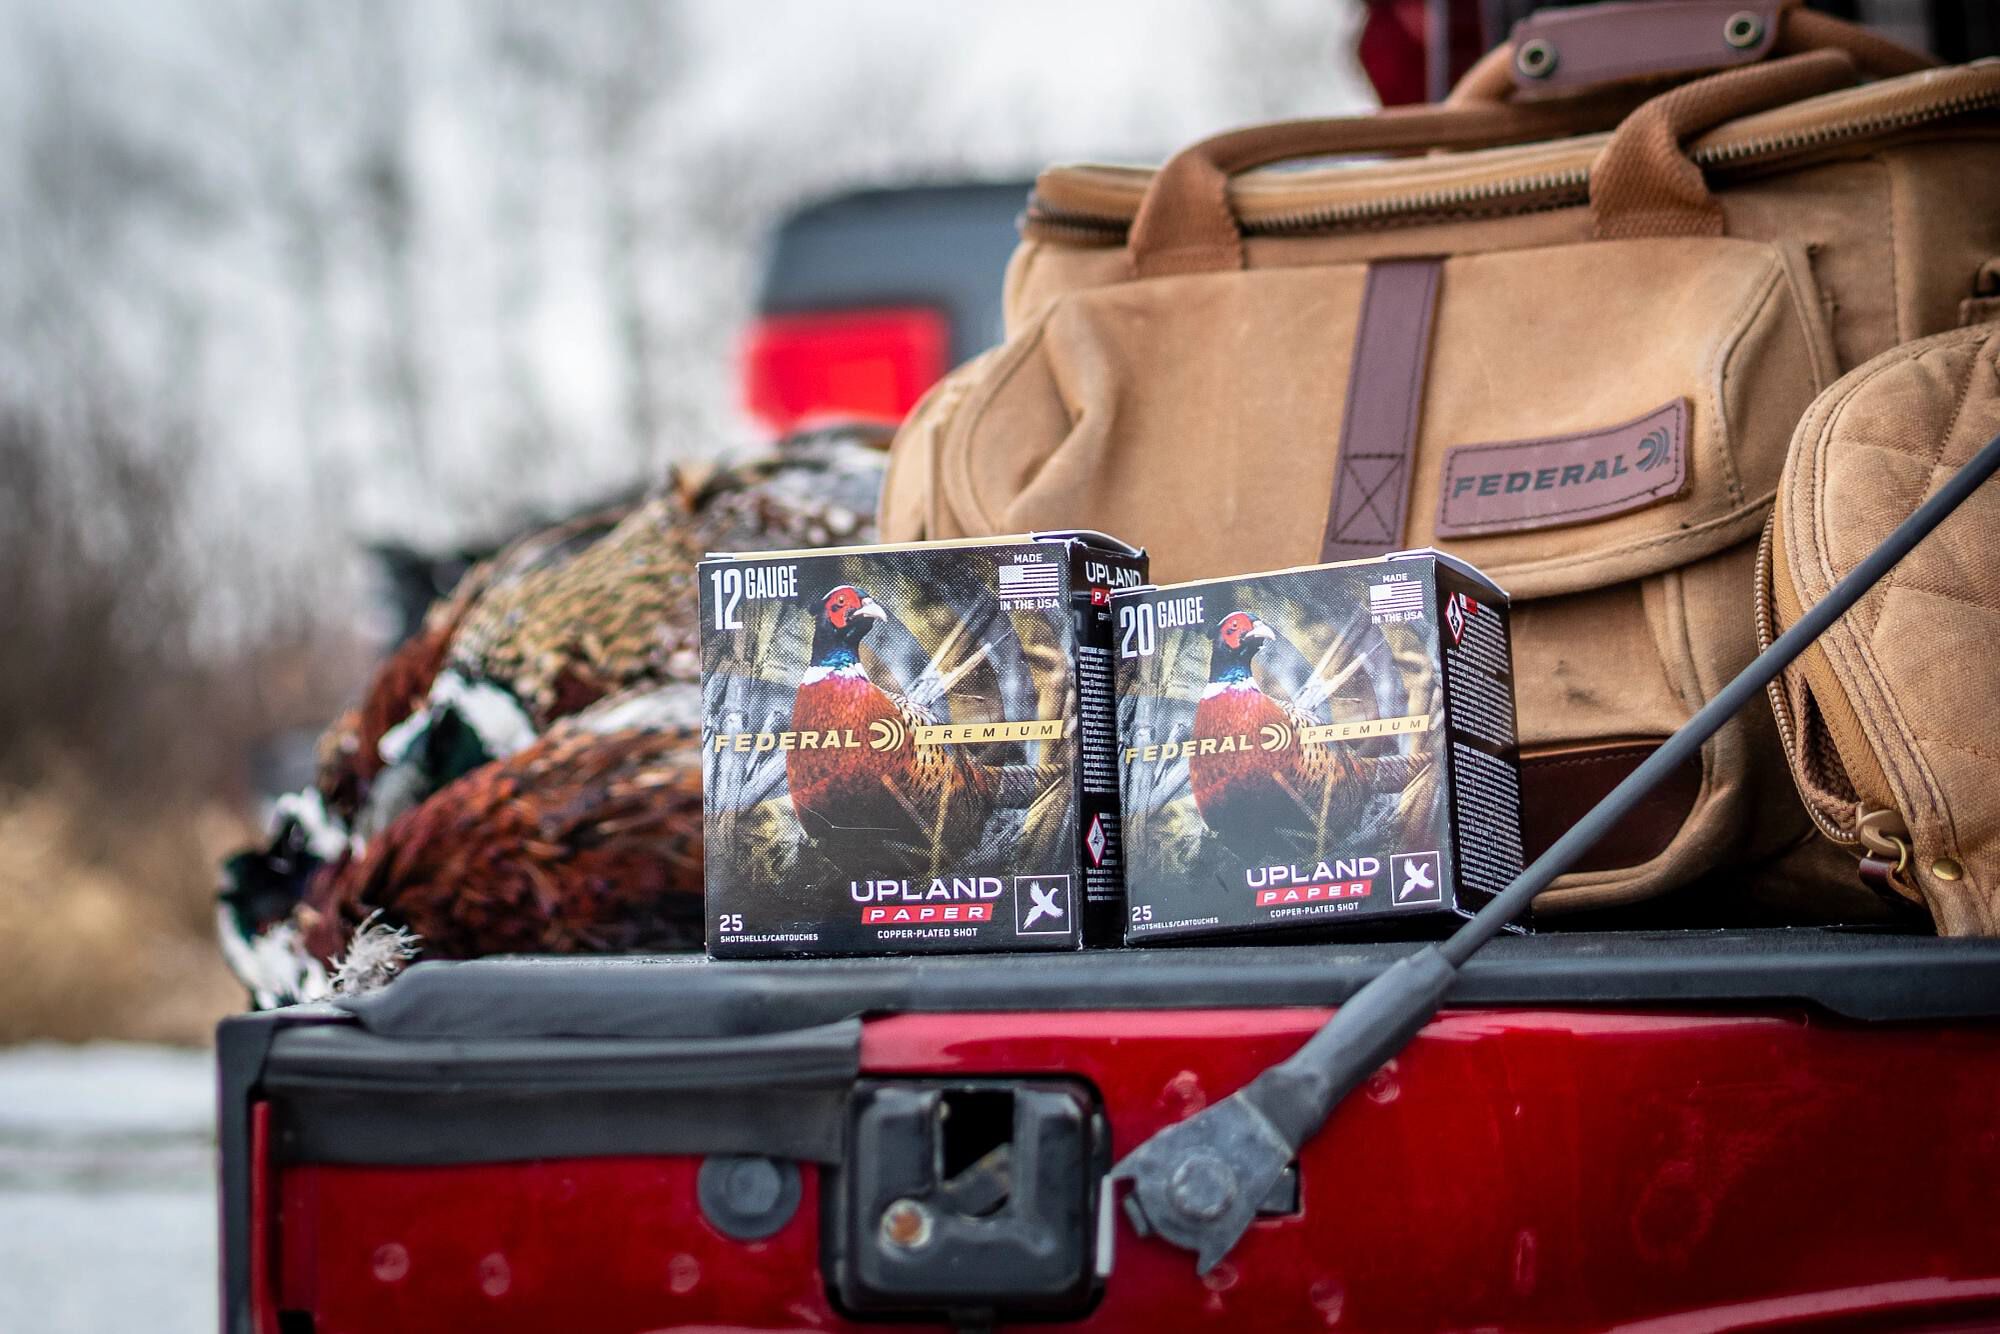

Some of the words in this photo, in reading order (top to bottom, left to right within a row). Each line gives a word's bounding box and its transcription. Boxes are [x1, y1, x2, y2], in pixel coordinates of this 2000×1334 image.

[1453, 455, 1628, 498] FEDERAL
[1013, 554, 1042, 564] MADE
[1085, 561, 1141, 588] UPLAND
[1382, 573, 1408, 583] MADE
[711, 568, 743, 630] 12
[745, 565, 798, 599] GAUGE
[1000, 601, 1012, 610] IN
[1013, 600, 1035, 610] THE
[1036, 599, 1059, 609] USA
[1371, 615, 1382, 624] IN
[1383, 613, 1402, 623] THE
[1403, 611, 1424, 622] USA
[1120, 603, 1155, 659] 20
[1157, 597, 1204, 628] GAUGE
[713, 729, 861, 753] FEDERAL
[924, 724, 1054, 741] PREMIUM
[1125, 735, 1254, 763] FEDERAL
[1308, 720, 1422, 739] PREMIUM
[1246, 857, 1380, 887] UPLAND
[851, 877, 1002, 902] UPLAND
[1263, 883, 1364, 903] PAPER
[869, 907, 985, 921] PAPER
[1132, 905, 1152, 922] 25
[1270, 905, 1335, 918] COPPER-PLATED
[1336, 902, 1358, 914] SHOT
[719, 914, 743, 932] 25
[1133, 917, 1219, 931] SHOTSHELLS/CARTOUCHES
[720, 933, 819, 943] SHOTSHELLS/CARTOUCHES
[877, 928, 949, 939] COPPER-PLATED
[952, 927, 977, 938] SHOT
